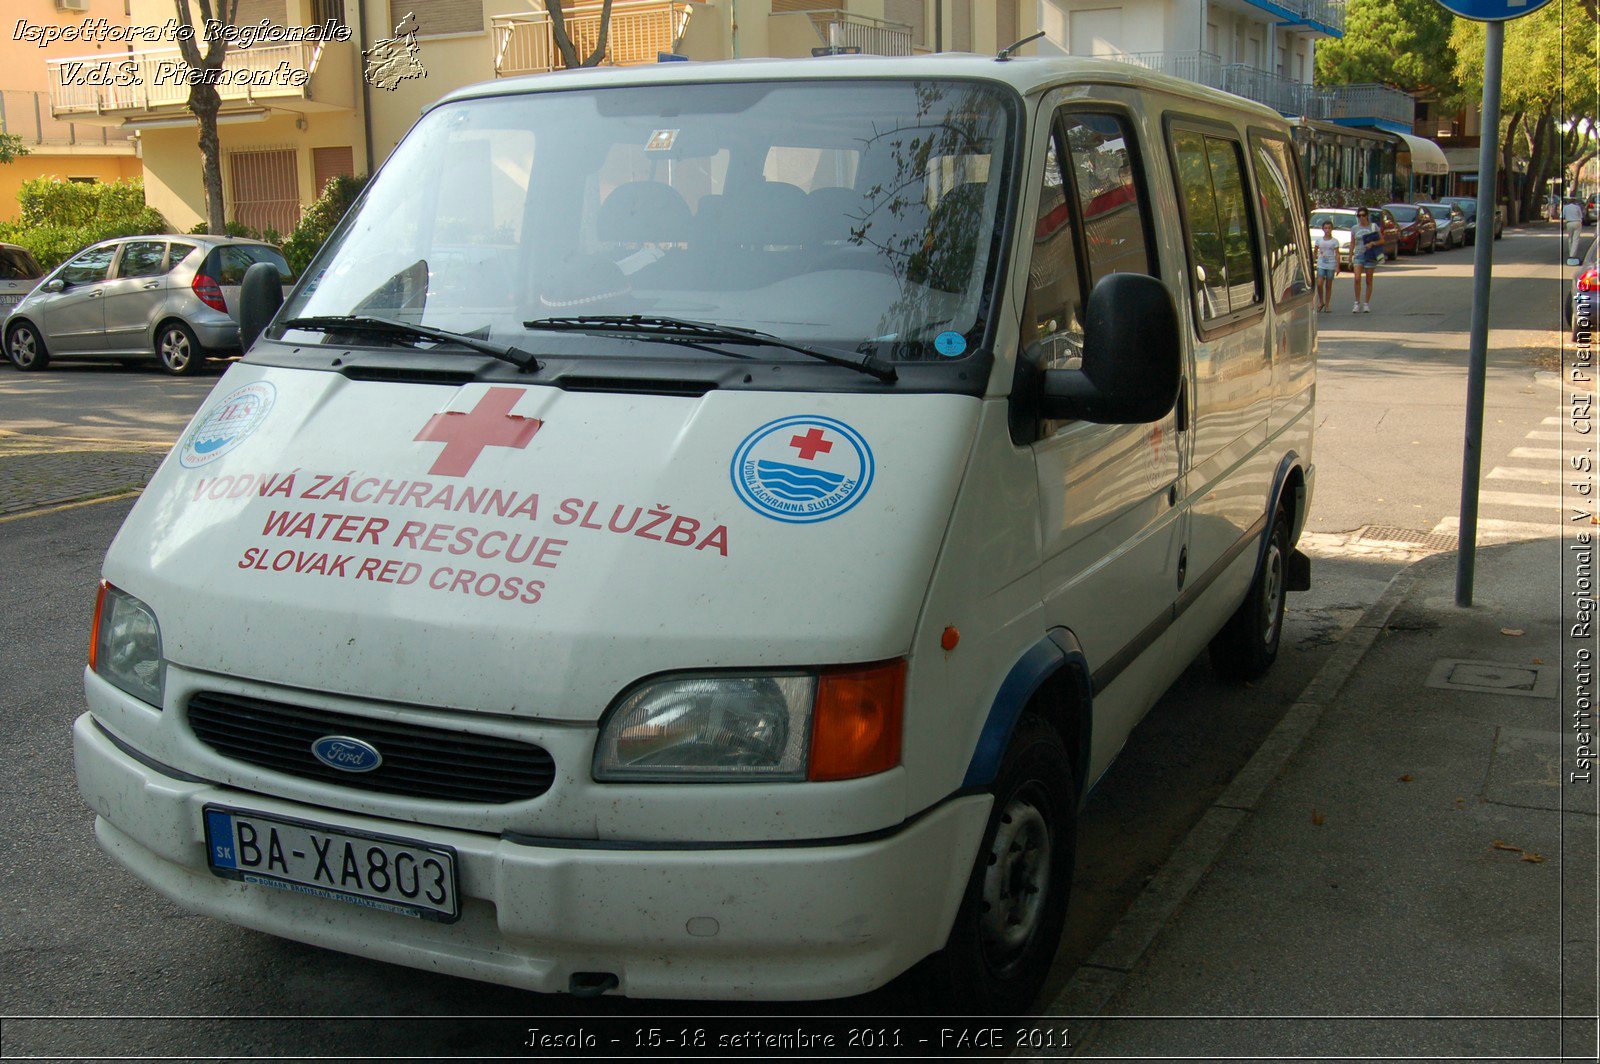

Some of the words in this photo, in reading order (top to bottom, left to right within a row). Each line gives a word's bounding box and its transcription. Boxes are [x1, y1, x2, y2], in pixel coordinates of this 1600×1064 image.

[193, 468, 301, 502] VODNÁ
[300, 470, 540, 521] ZÁCHRANNA
[552, 498, 730, 557] SLUŽBA
[262, 510, 389, 545] WATER
[393, 520, 569, 568] RESCUE
[238, 547, 355, 577] SLOVAK
[355, 557, 422, 585] RED
[429, 566, 546, 604] CROSS
[327, 741, 365, 765] Ford
[216, 846, 232, 860] SK
[236, 821, 447, 906] BA-XA803
